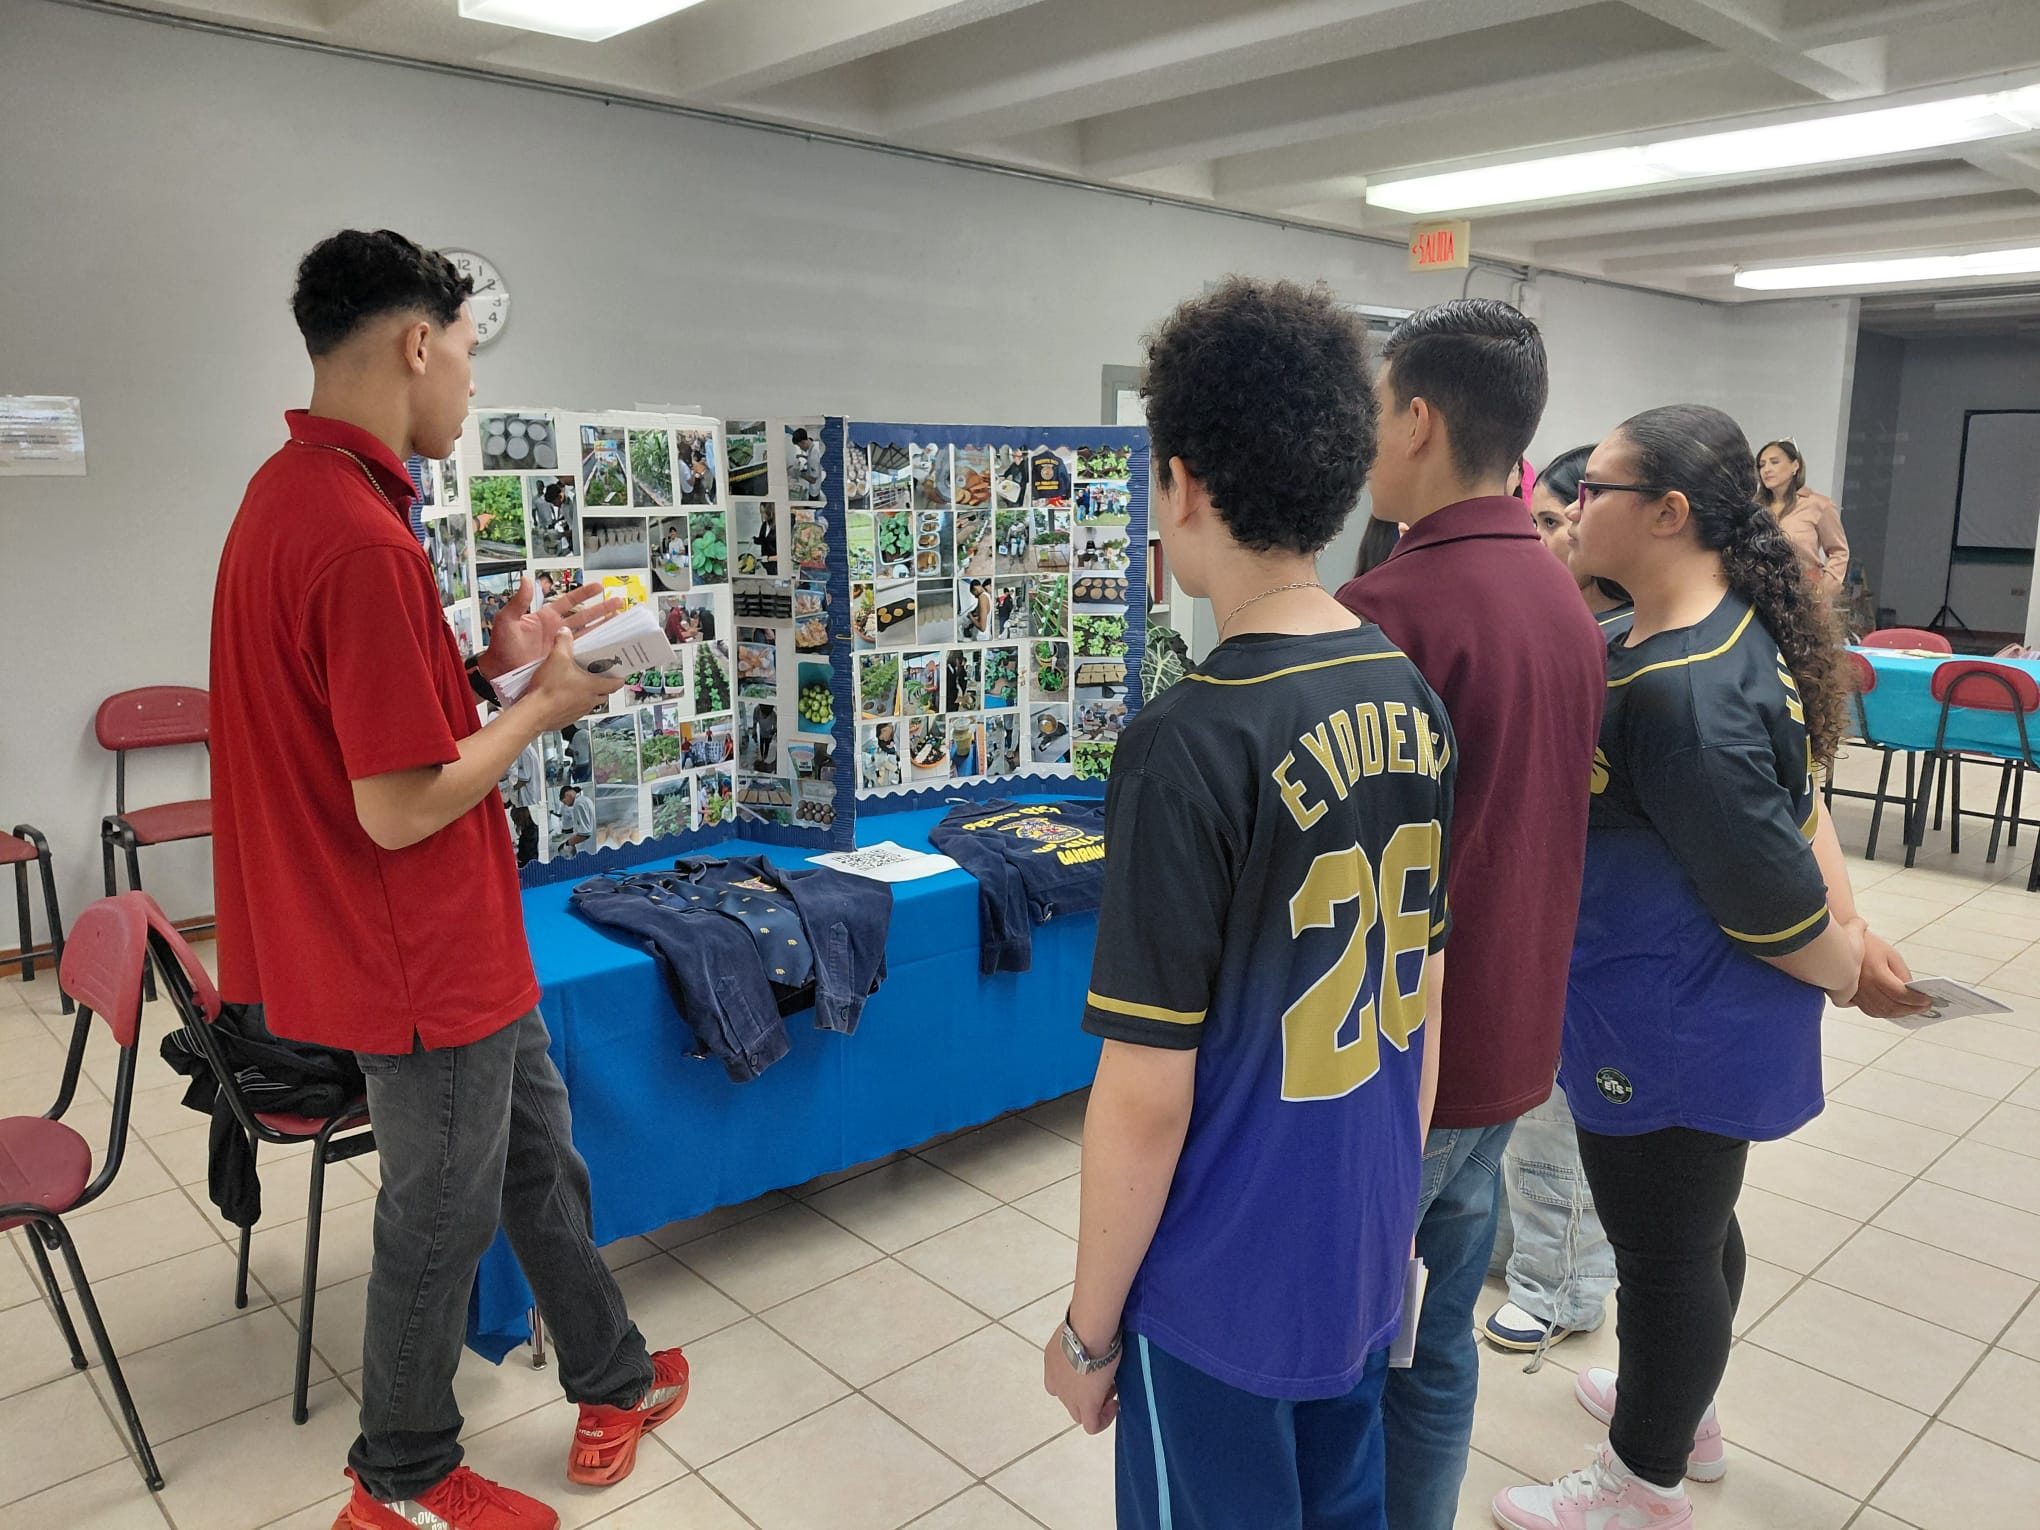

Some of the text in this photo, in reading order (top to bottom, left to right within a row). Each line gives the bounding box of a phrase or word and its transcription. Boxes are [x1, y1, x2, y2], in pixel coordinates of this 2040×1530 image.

[1418, 231, 1455, 265] SALIDA
[458, 259, 471, 271] 12
[478, 266, 483, 276] 1
[487, 279, 496, 290] 2
[492, 298, 502, 307] 3
[488, 312, 498, 322] 4
[478, 323, 488, 335] 5
[1056, 844, 1105, 865] BARRAN
[1280, 818, 1443, 1102] 26
